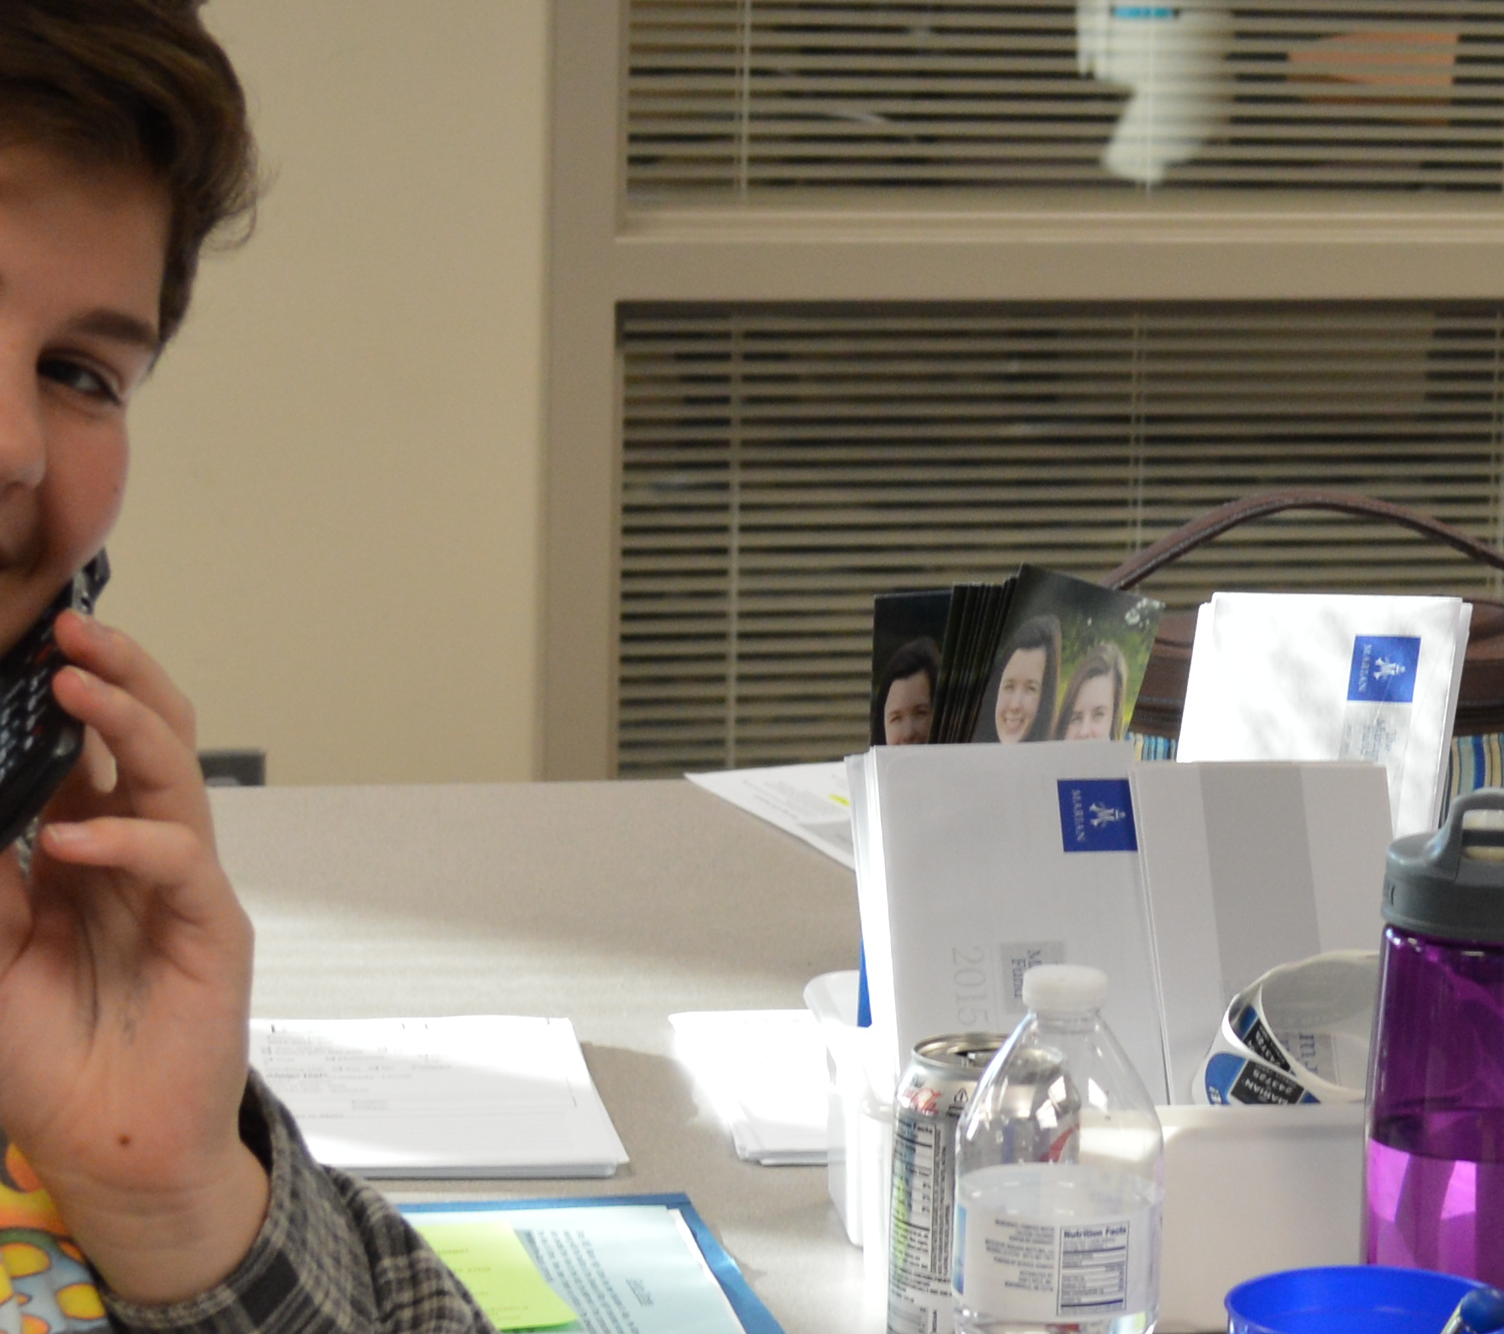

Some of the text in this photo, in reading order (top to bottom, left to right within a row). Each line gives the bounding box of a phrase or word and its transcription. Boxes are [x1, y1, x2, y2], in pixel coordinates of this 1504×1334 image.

[1071, 788, 1087, 843] MARIAN
[952, 944, 989, 1028] 2015
[1063, 1226, 1127, 1239] Nutrition Facts
